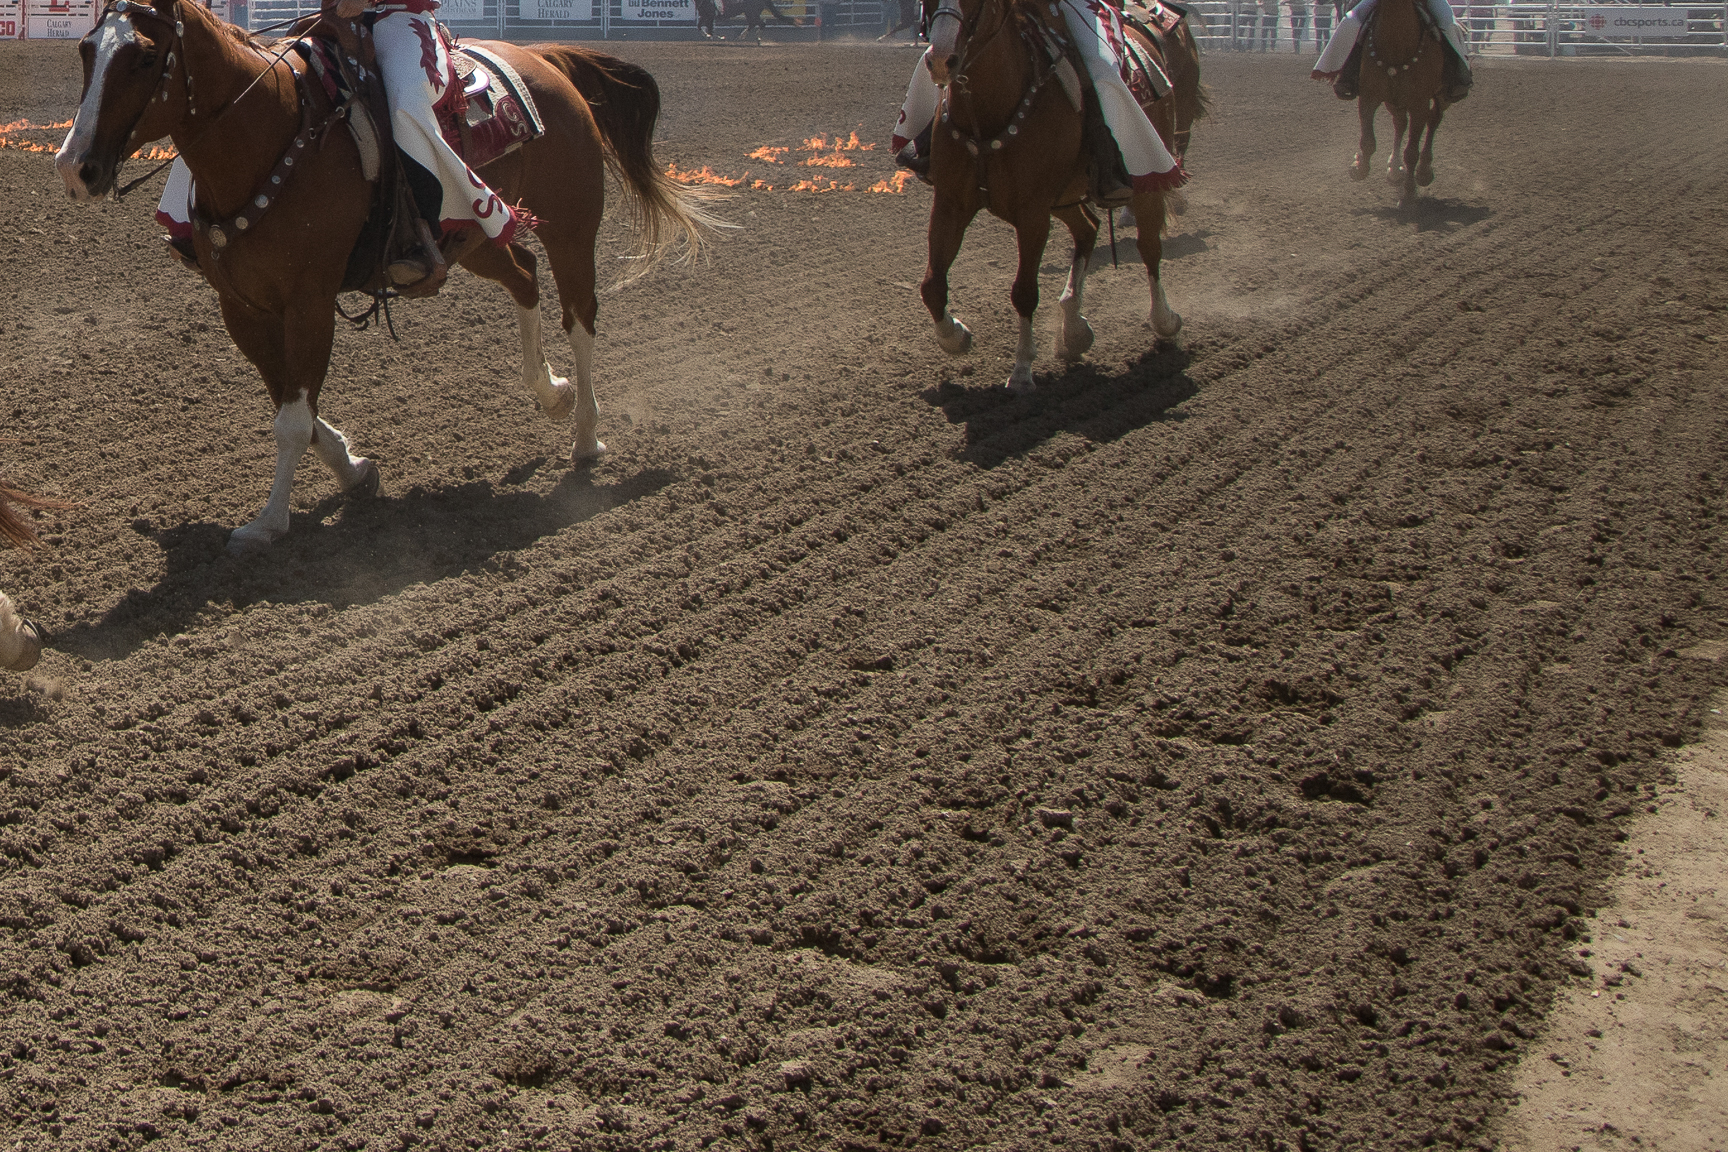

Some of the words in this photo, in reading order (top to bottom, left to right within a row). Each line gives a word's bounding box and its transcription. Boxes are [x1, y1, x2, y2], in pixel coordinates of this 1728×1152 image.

[537, 8, 570, 19] HERALD
[637, 8, 674, 18] Jones
[46, 19, 72, 29] CALGARY
[1614, 16, 1684, 28] cbcsports.ca
[47, 29, 70, 38] HERALD
